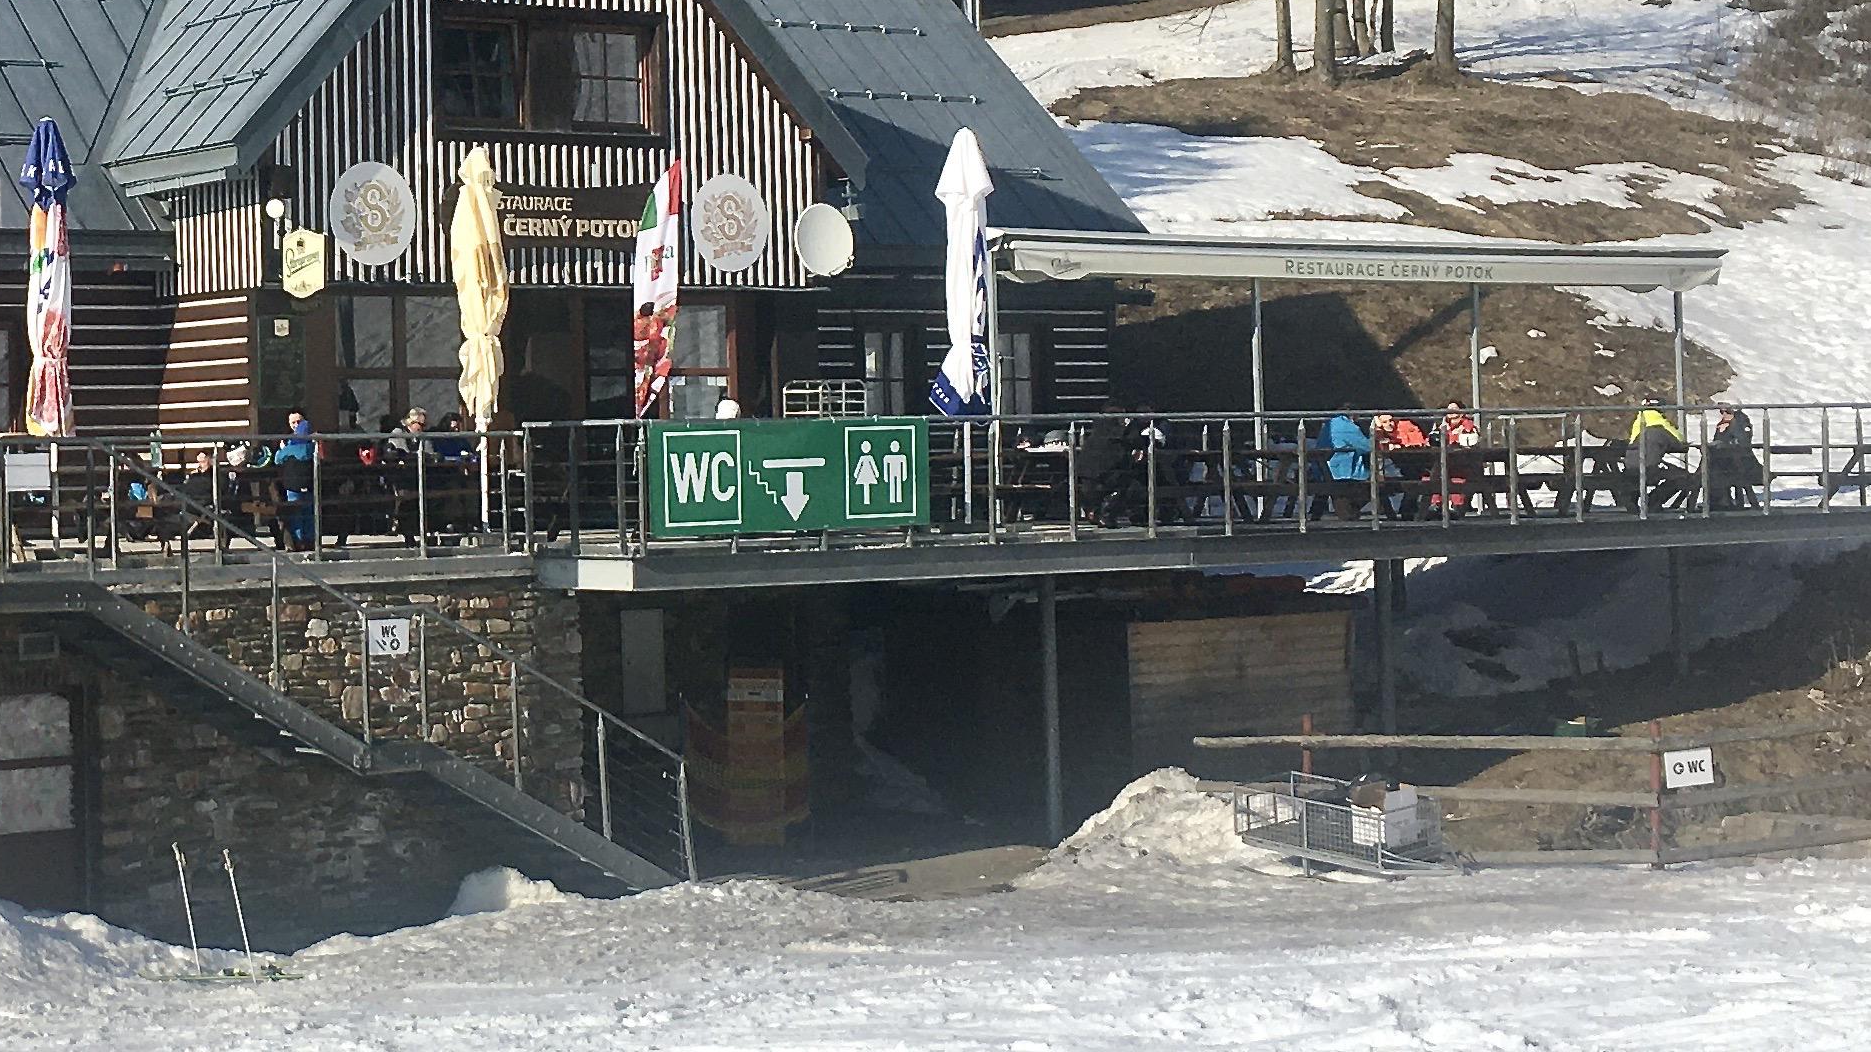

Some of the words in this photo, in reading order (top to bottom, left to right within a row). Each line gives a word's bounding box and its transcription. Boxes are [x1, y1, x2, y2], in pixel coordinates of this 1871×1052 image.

[497, 195, 573, 212] STAURACE
[503, 214, 572, 237] ČERNÝ
[1285, 259, 1385, 277] RESTAURACE
[1391, 260, 1440, 279] ČERNÝ
[1445, 265, 1494, 279] POTOK
[670, 451, 736, 504] WC
[381, 624, 397, 638] WC
[1687, 759, 1706, 774] WC
